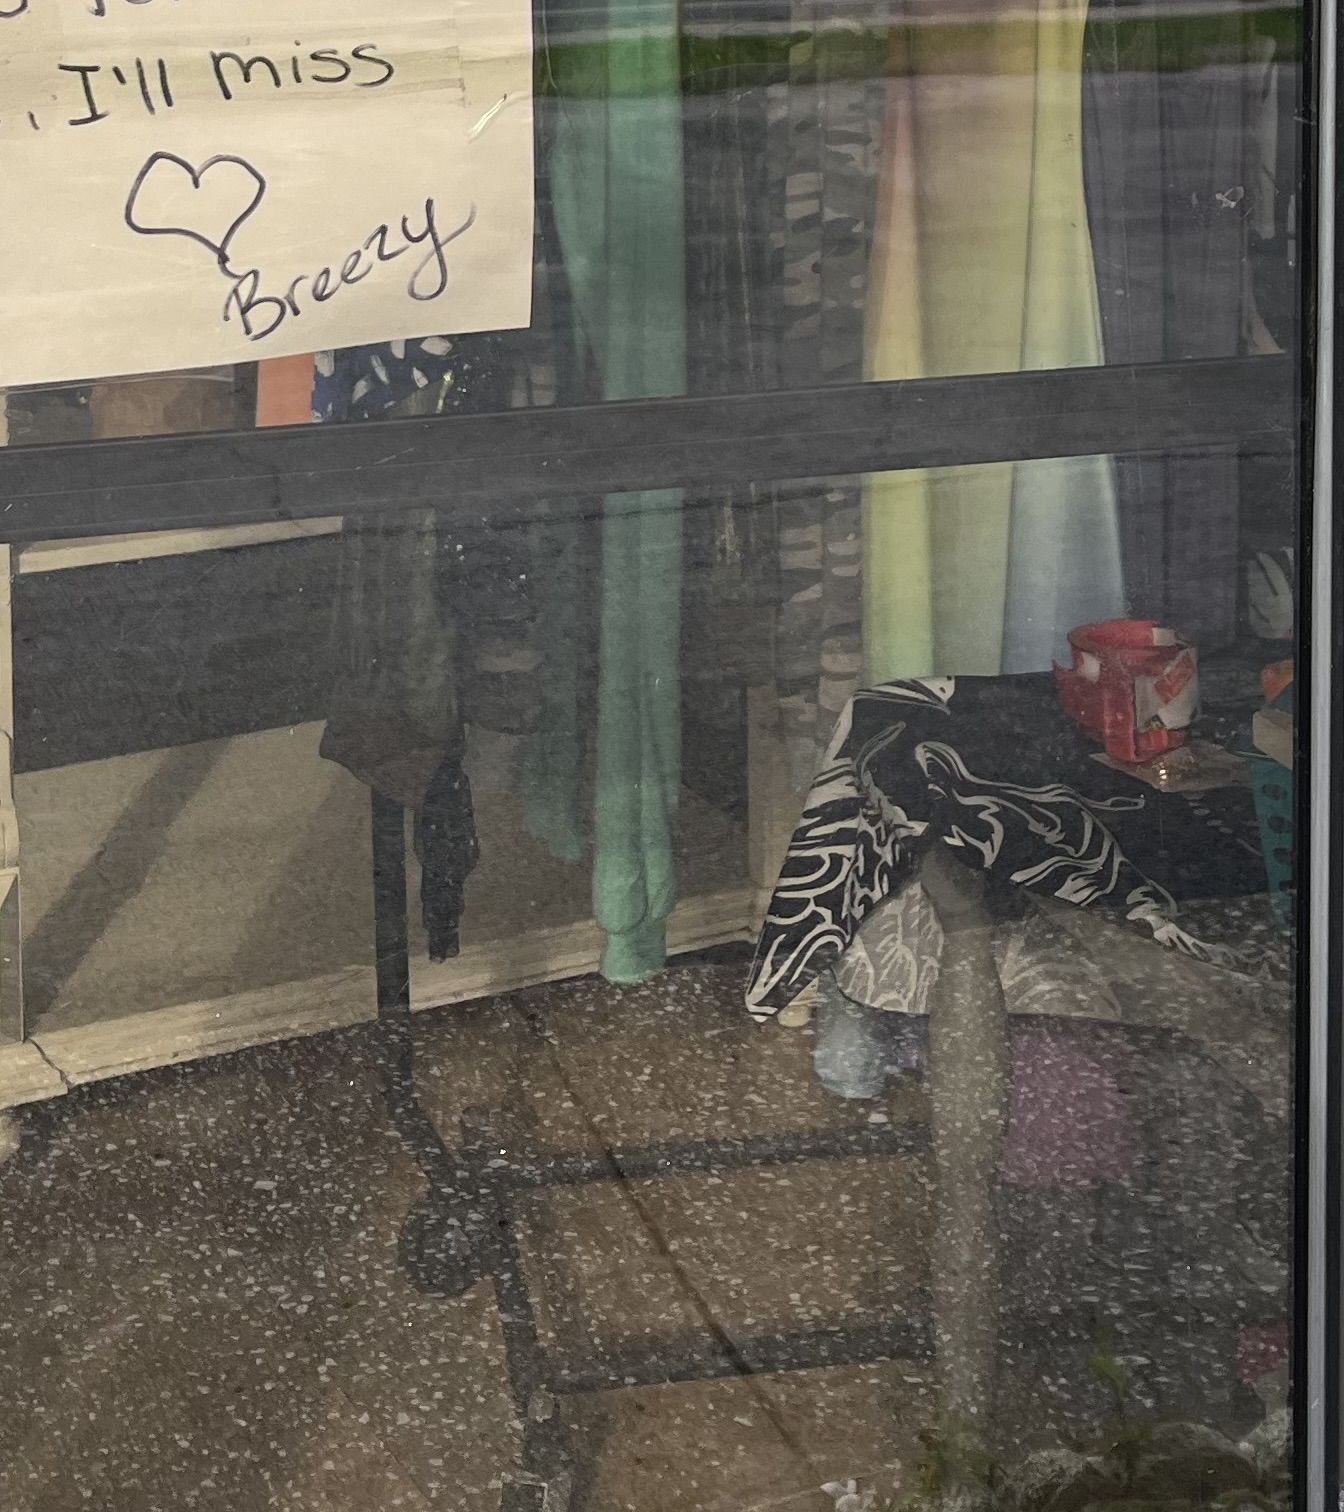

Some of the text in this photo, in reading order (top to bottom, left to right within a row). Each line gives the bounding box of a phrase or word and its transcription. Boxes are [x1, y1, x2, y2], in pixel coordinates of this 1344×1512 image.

[57, 56, 173, 128] I'll
[214, 41, 394, 89] miss
[223, 198, 476, 343] Breezy
